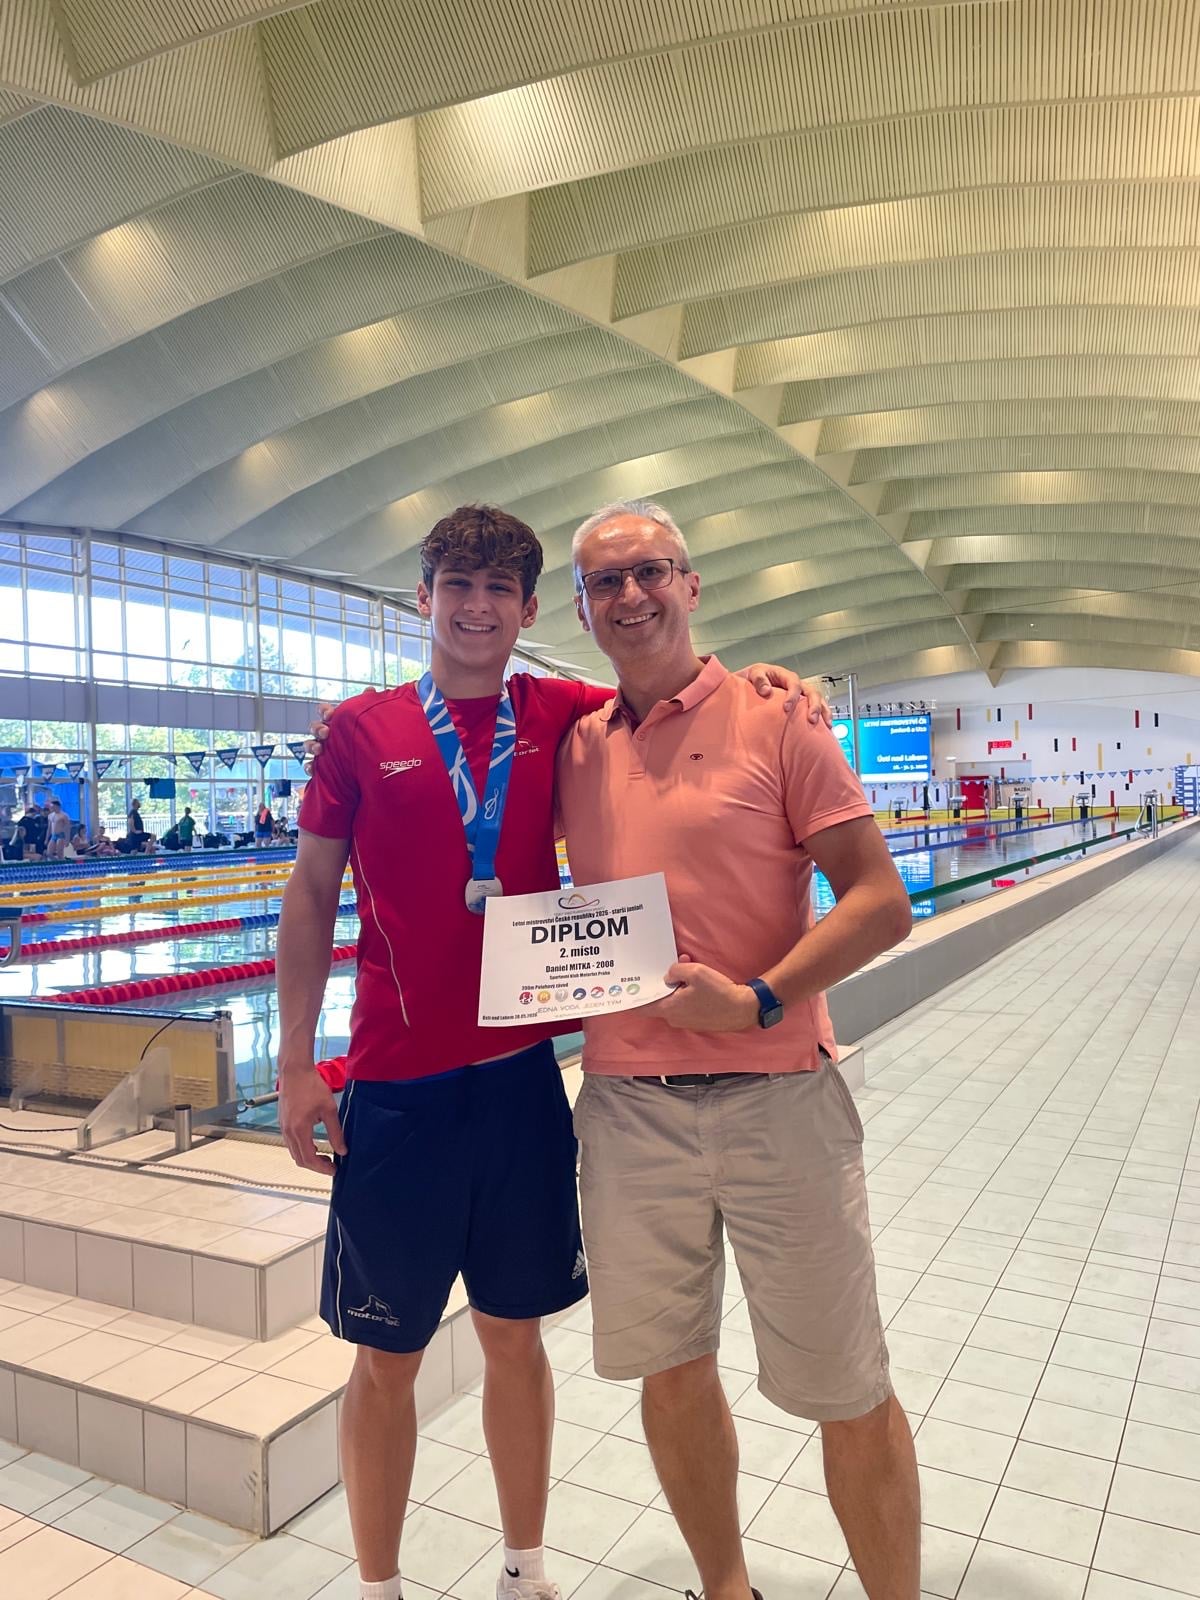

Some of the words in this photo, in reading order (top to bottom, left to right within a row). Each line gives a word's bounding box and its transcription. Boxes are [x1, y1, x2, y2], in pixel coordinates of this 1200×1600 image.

[379, 757, 422, 770] speedo
[531, 916, 629, 944] DIPLOM
[560, 947, 569, 958] 2.
[571, 945, 600, 958] místo
[545, 963, 568, 973] Daniel
[569, 962, 591, 971] MITKA
[596, 960, 614, 969] 2008
